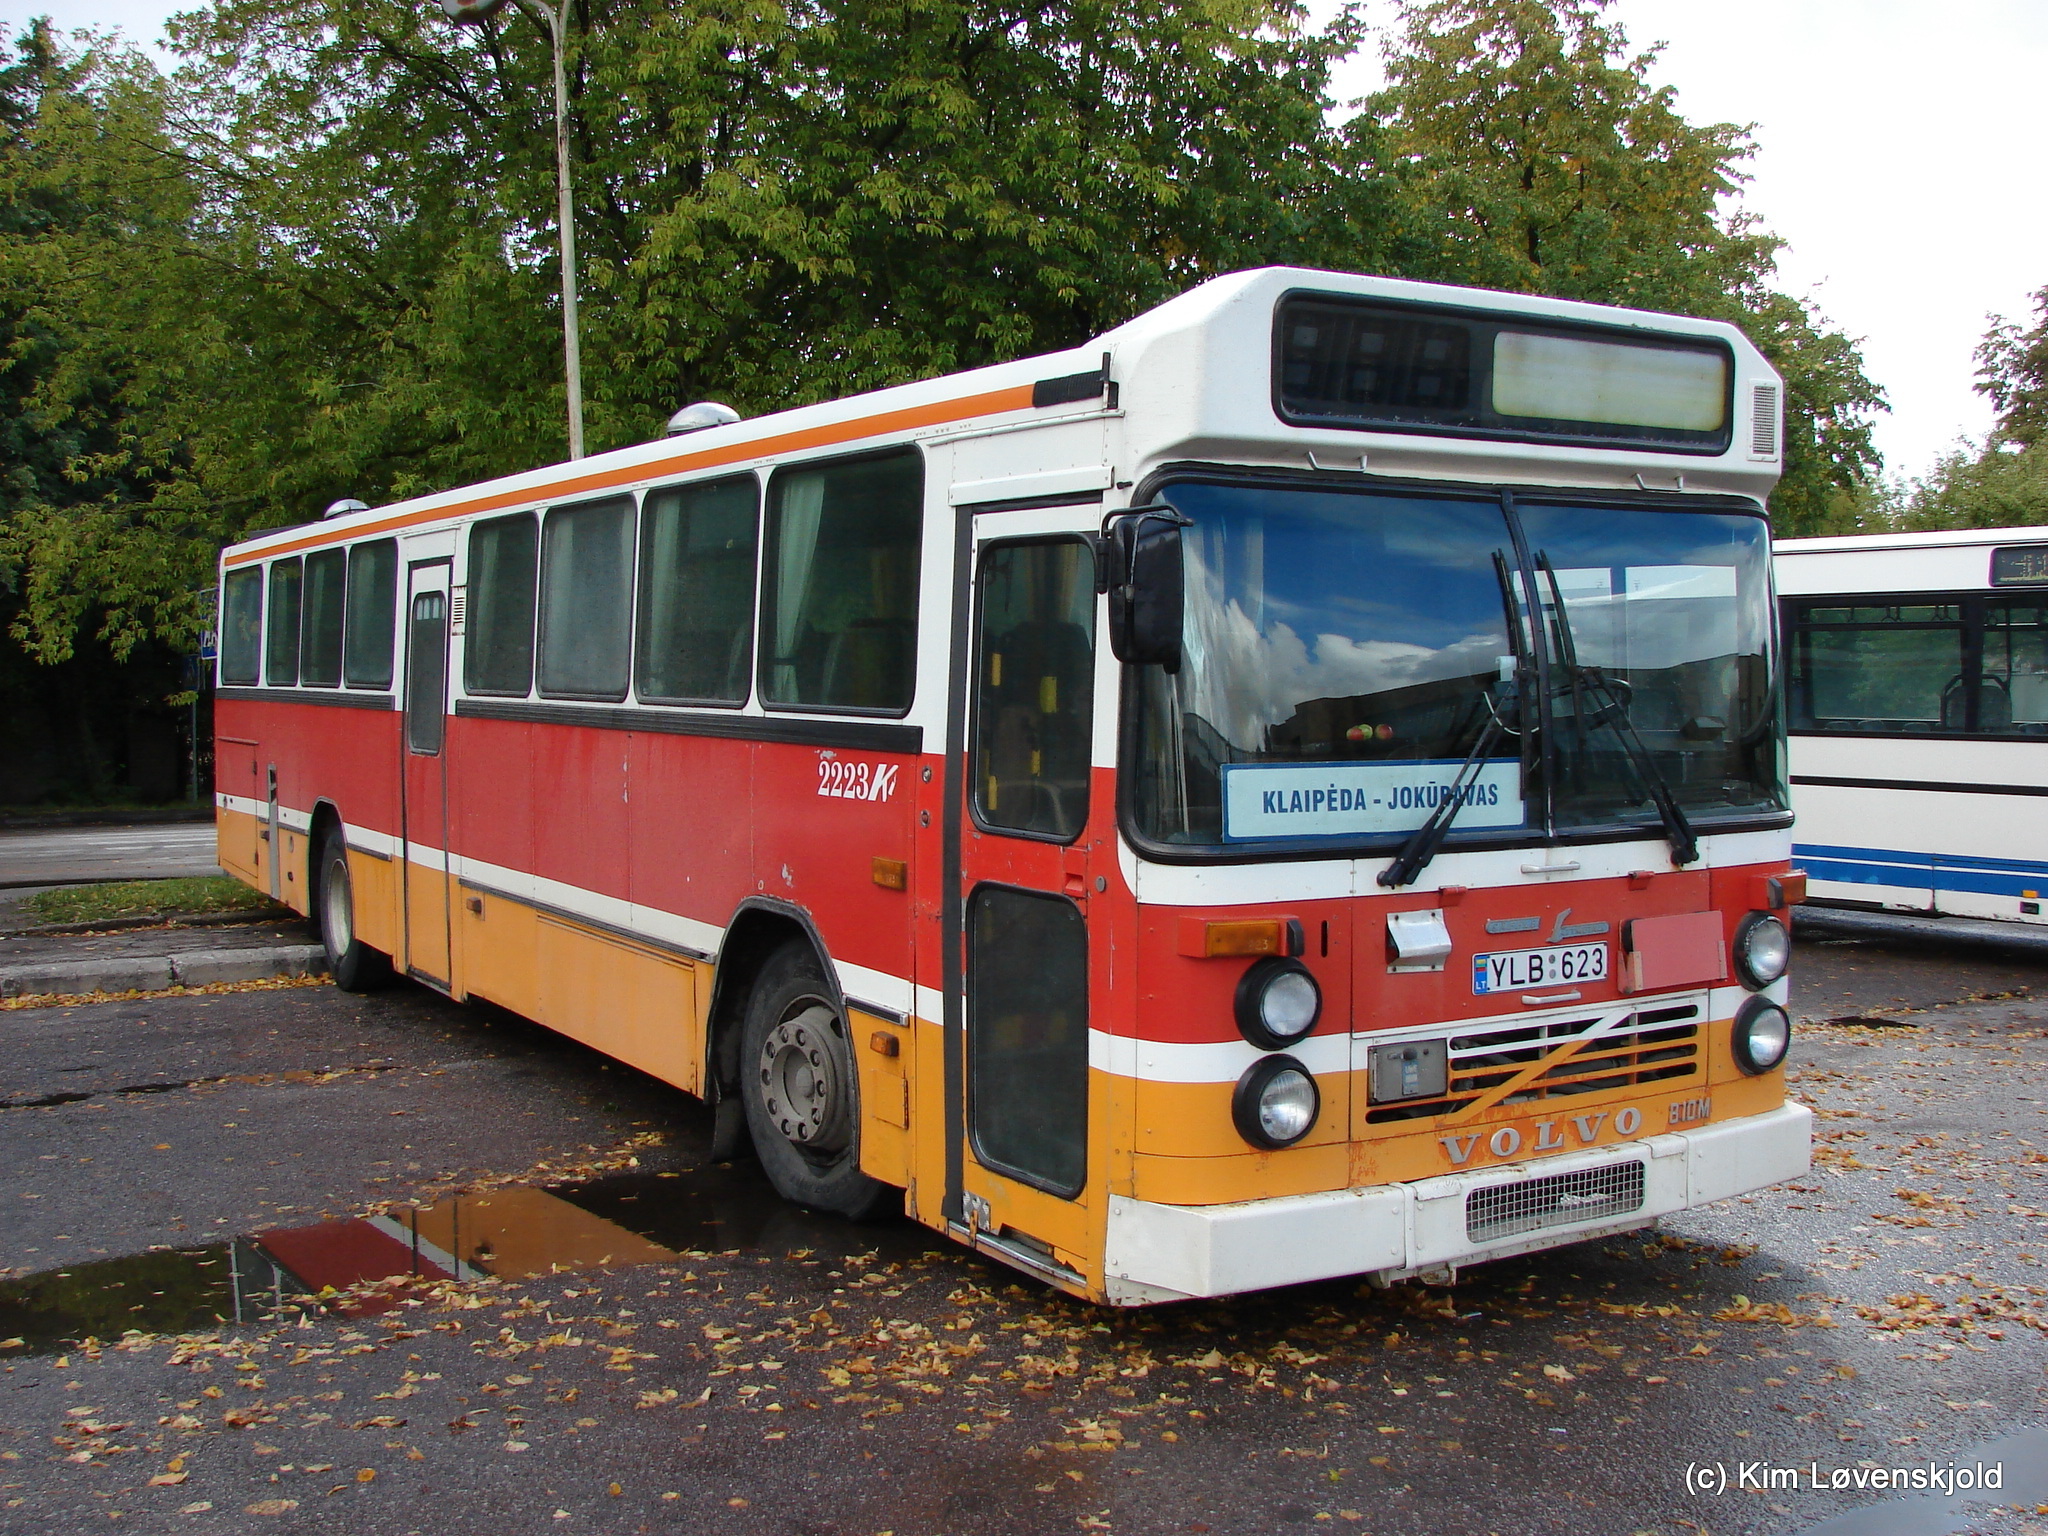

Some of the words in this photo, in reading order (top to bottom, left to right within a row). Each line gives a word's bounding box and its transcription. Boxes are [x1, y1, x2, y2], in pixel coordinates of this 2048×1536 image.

[1262, 783, 1367, 814] KLAIPĖDA
[1491, 954, 1544, 987] YLB
[1561, 948, 1603, 980] 623
[1475, 981, 1486, 990] LT
[1669, 1097, 1711, 1124] B10M
[1439, 1107, 1642, 1164] VOLVO
